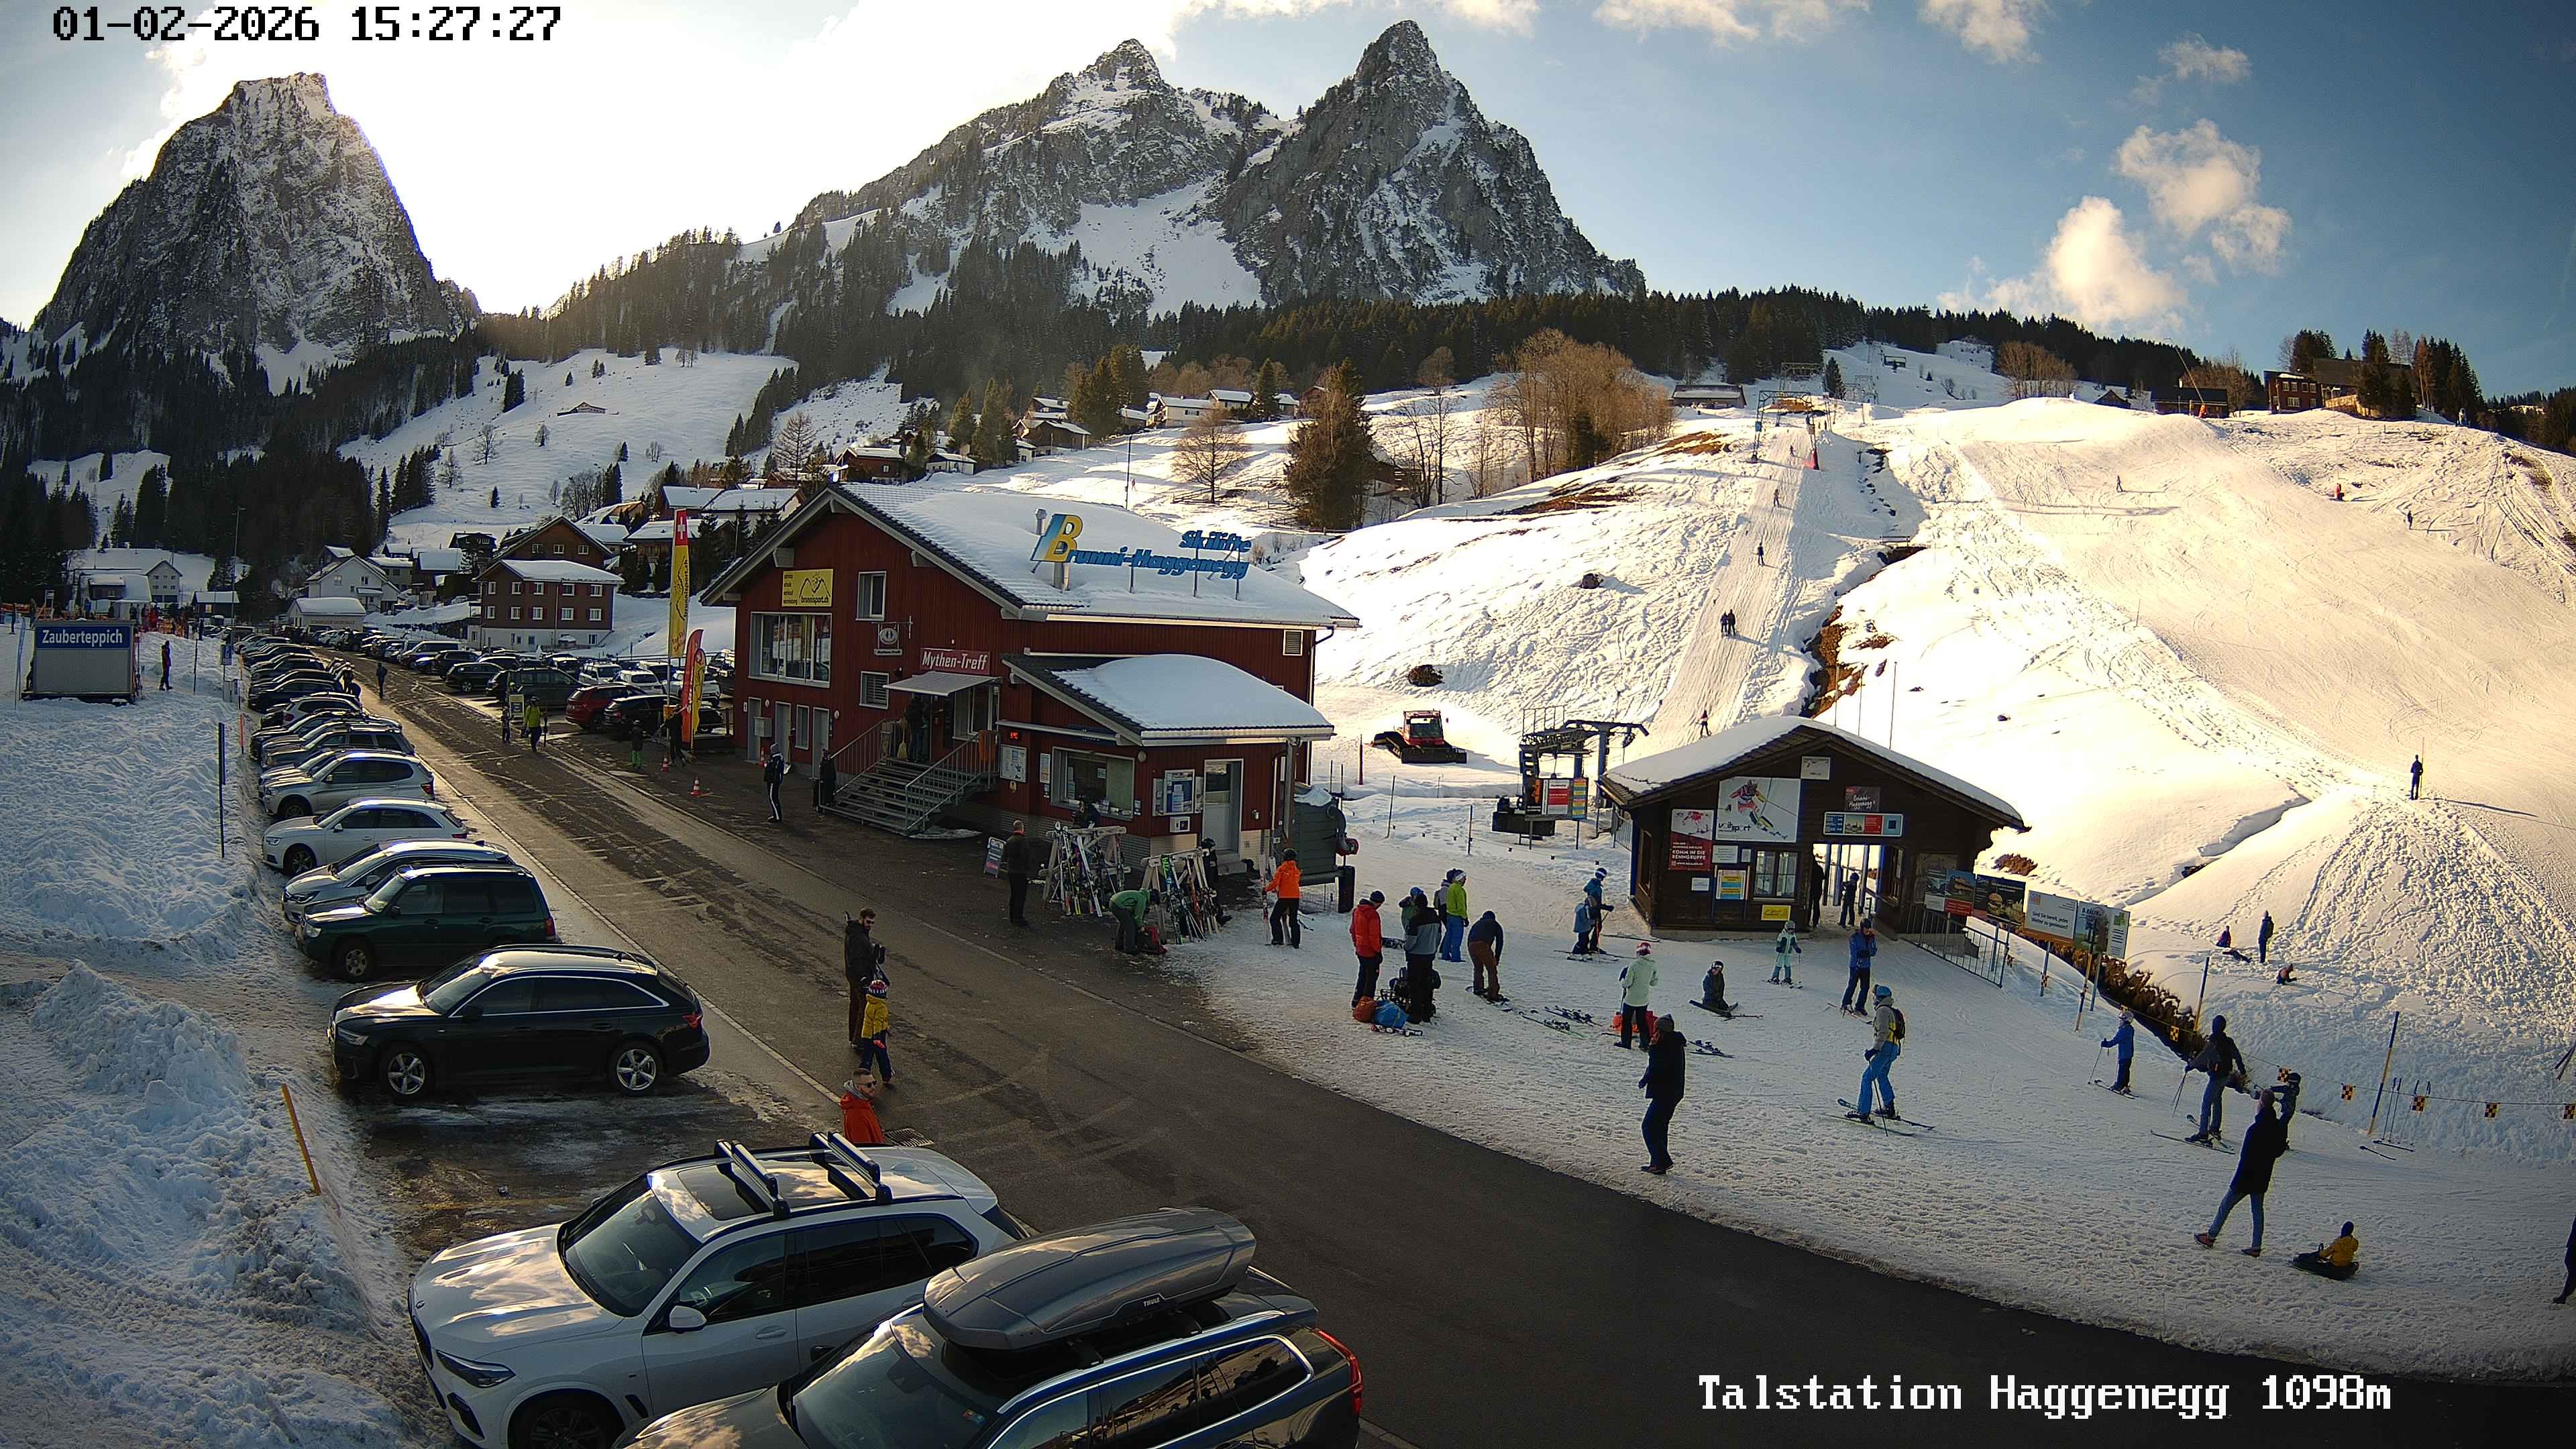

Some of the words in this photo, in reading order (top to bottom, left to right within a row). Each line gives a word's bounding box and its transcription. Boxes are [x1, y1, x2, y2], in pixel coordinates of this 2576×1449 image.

[1030, 513, 1250, 580] Brunni-Haggenegg
[1179, 531, 1252, 553] Skilifte
[801, 594, 829, 605] brunnisport.ch
[42, 629, 122, 647] Zauberteppich
[922, 651, 987, 670] Mythen-Treff
[1143, 1297, 1160, 1307] THULE
